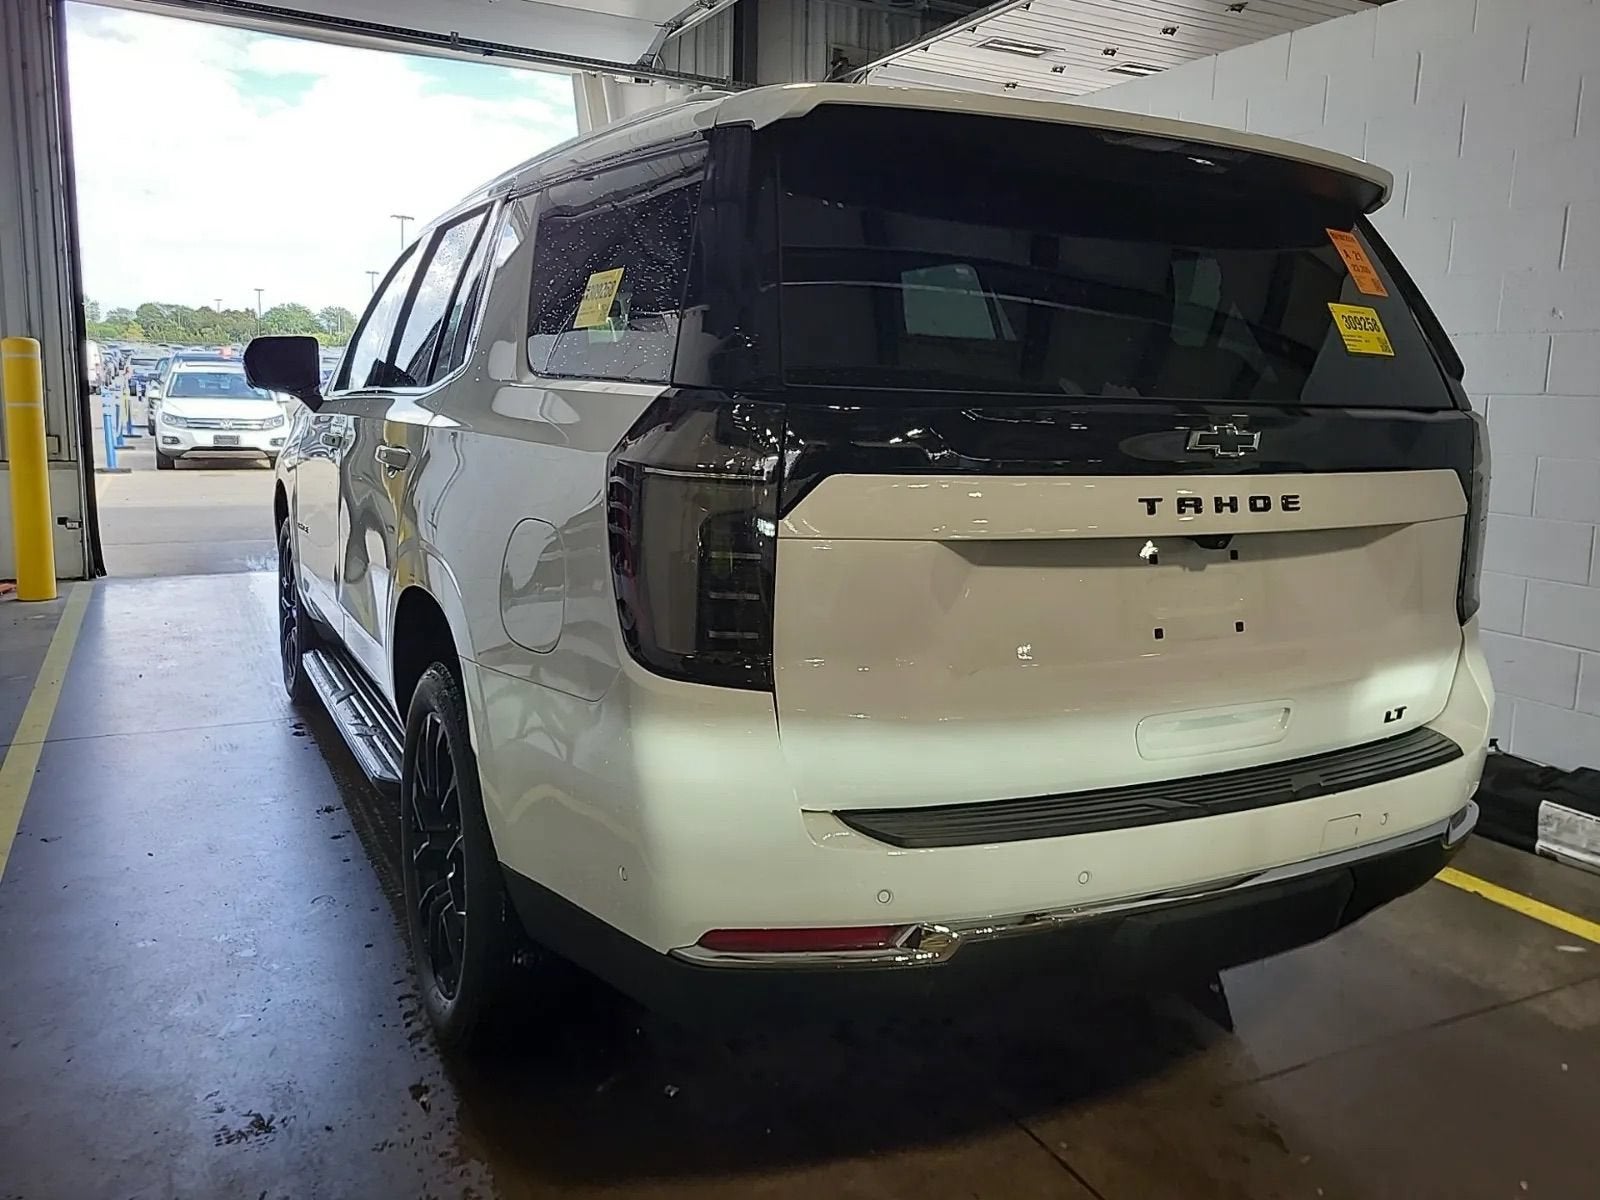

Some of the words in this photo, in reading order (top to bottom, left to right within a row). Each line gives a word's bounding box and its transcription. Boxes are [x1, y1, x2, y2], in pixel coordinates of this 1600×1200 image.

[1341, 314, 1381, 332] 309258
[1137, 494, 1301, 516] TAHOE
[1383, 705, 1407, 723] LT
